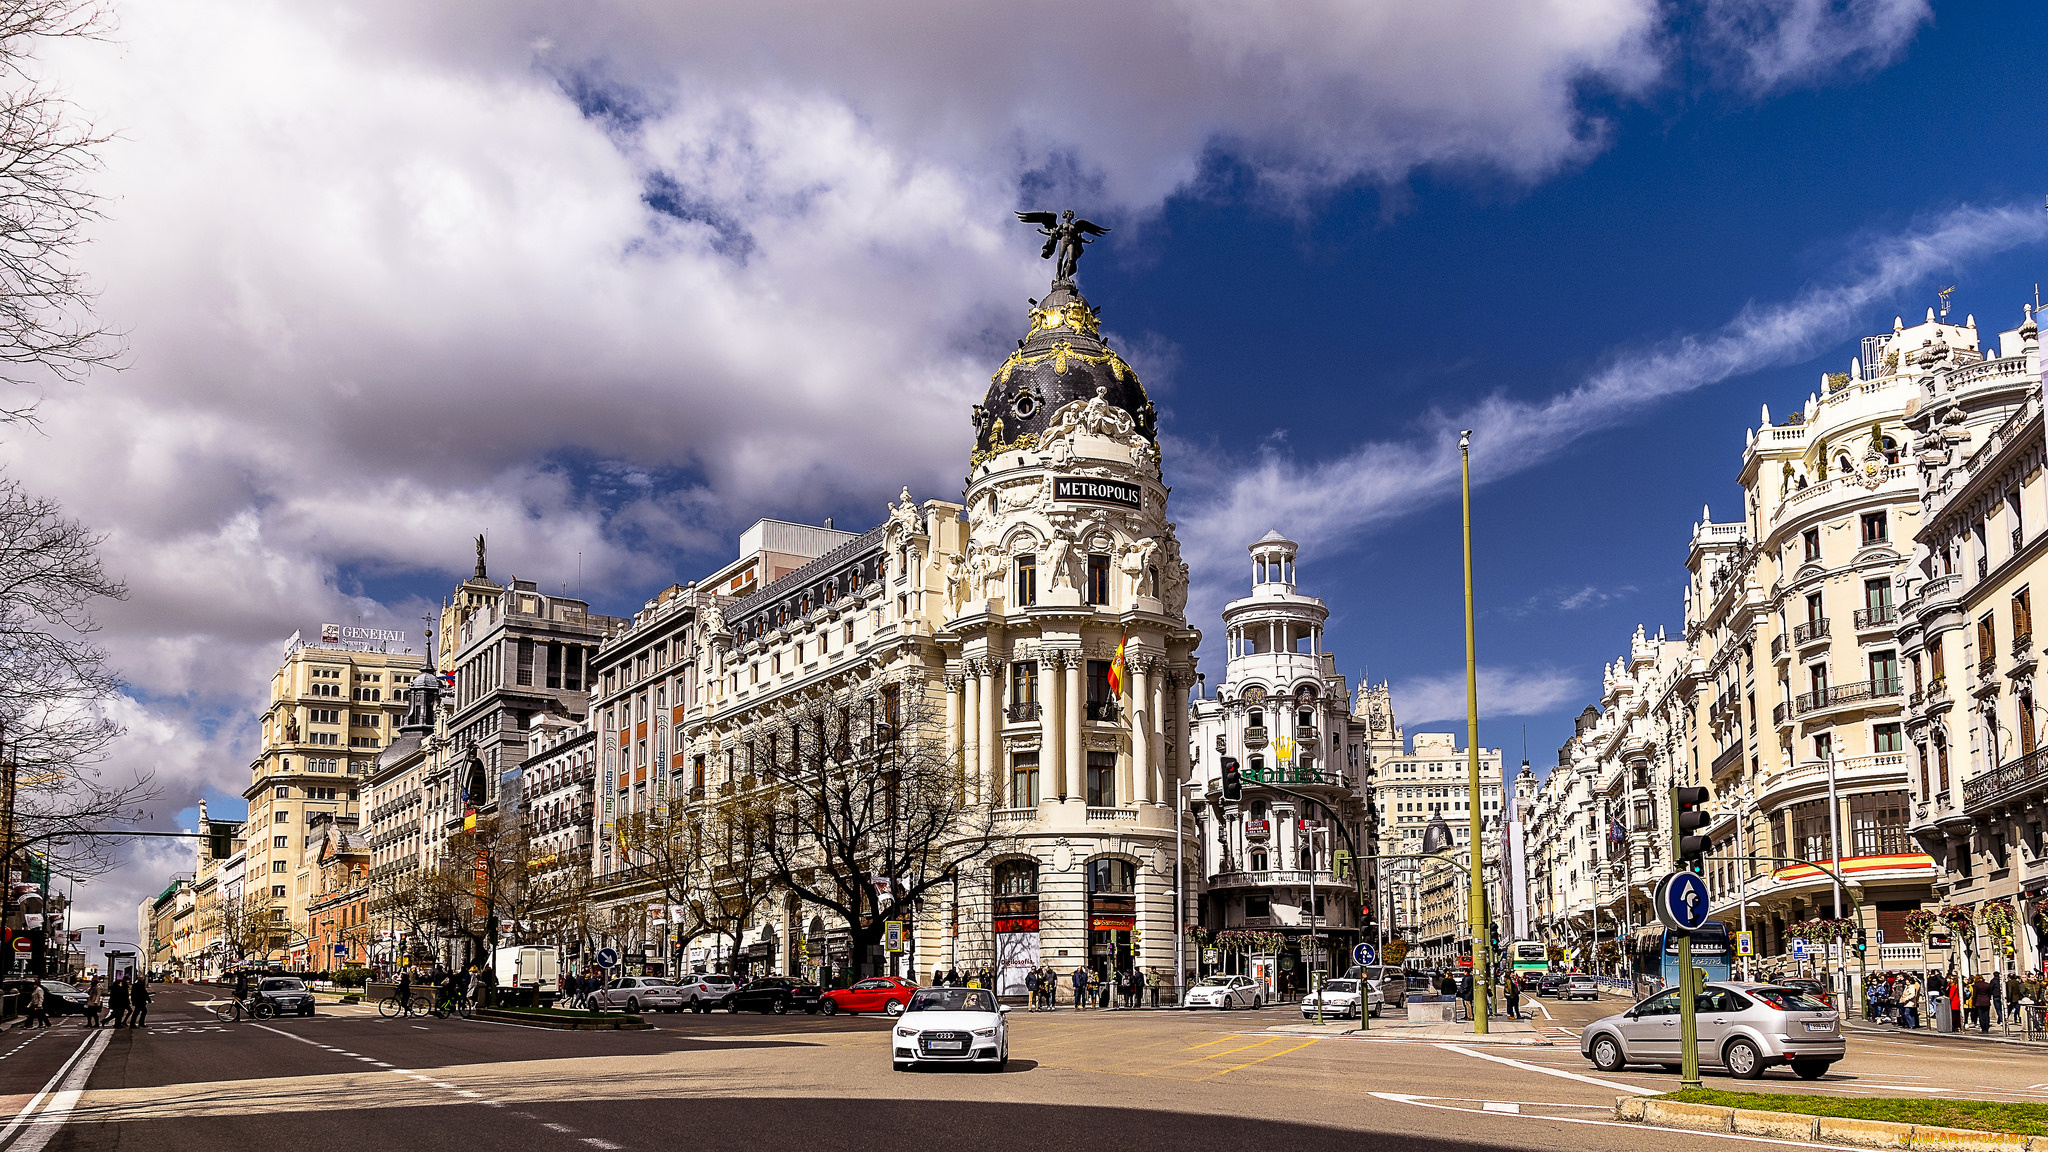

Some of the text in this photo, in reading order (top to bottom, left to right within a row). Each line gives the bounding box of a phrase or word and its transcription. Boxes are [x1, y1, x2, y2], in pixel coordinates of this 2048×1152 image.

[1059, 482, 1139, 503] METROPOLIS
[342, 626, 406, 642] GENERALI
[657, 751, 667, 797] hay salida
[1241, 766, 1326, 784] ROLEX
[604, 771, 614, 814] hay salida
